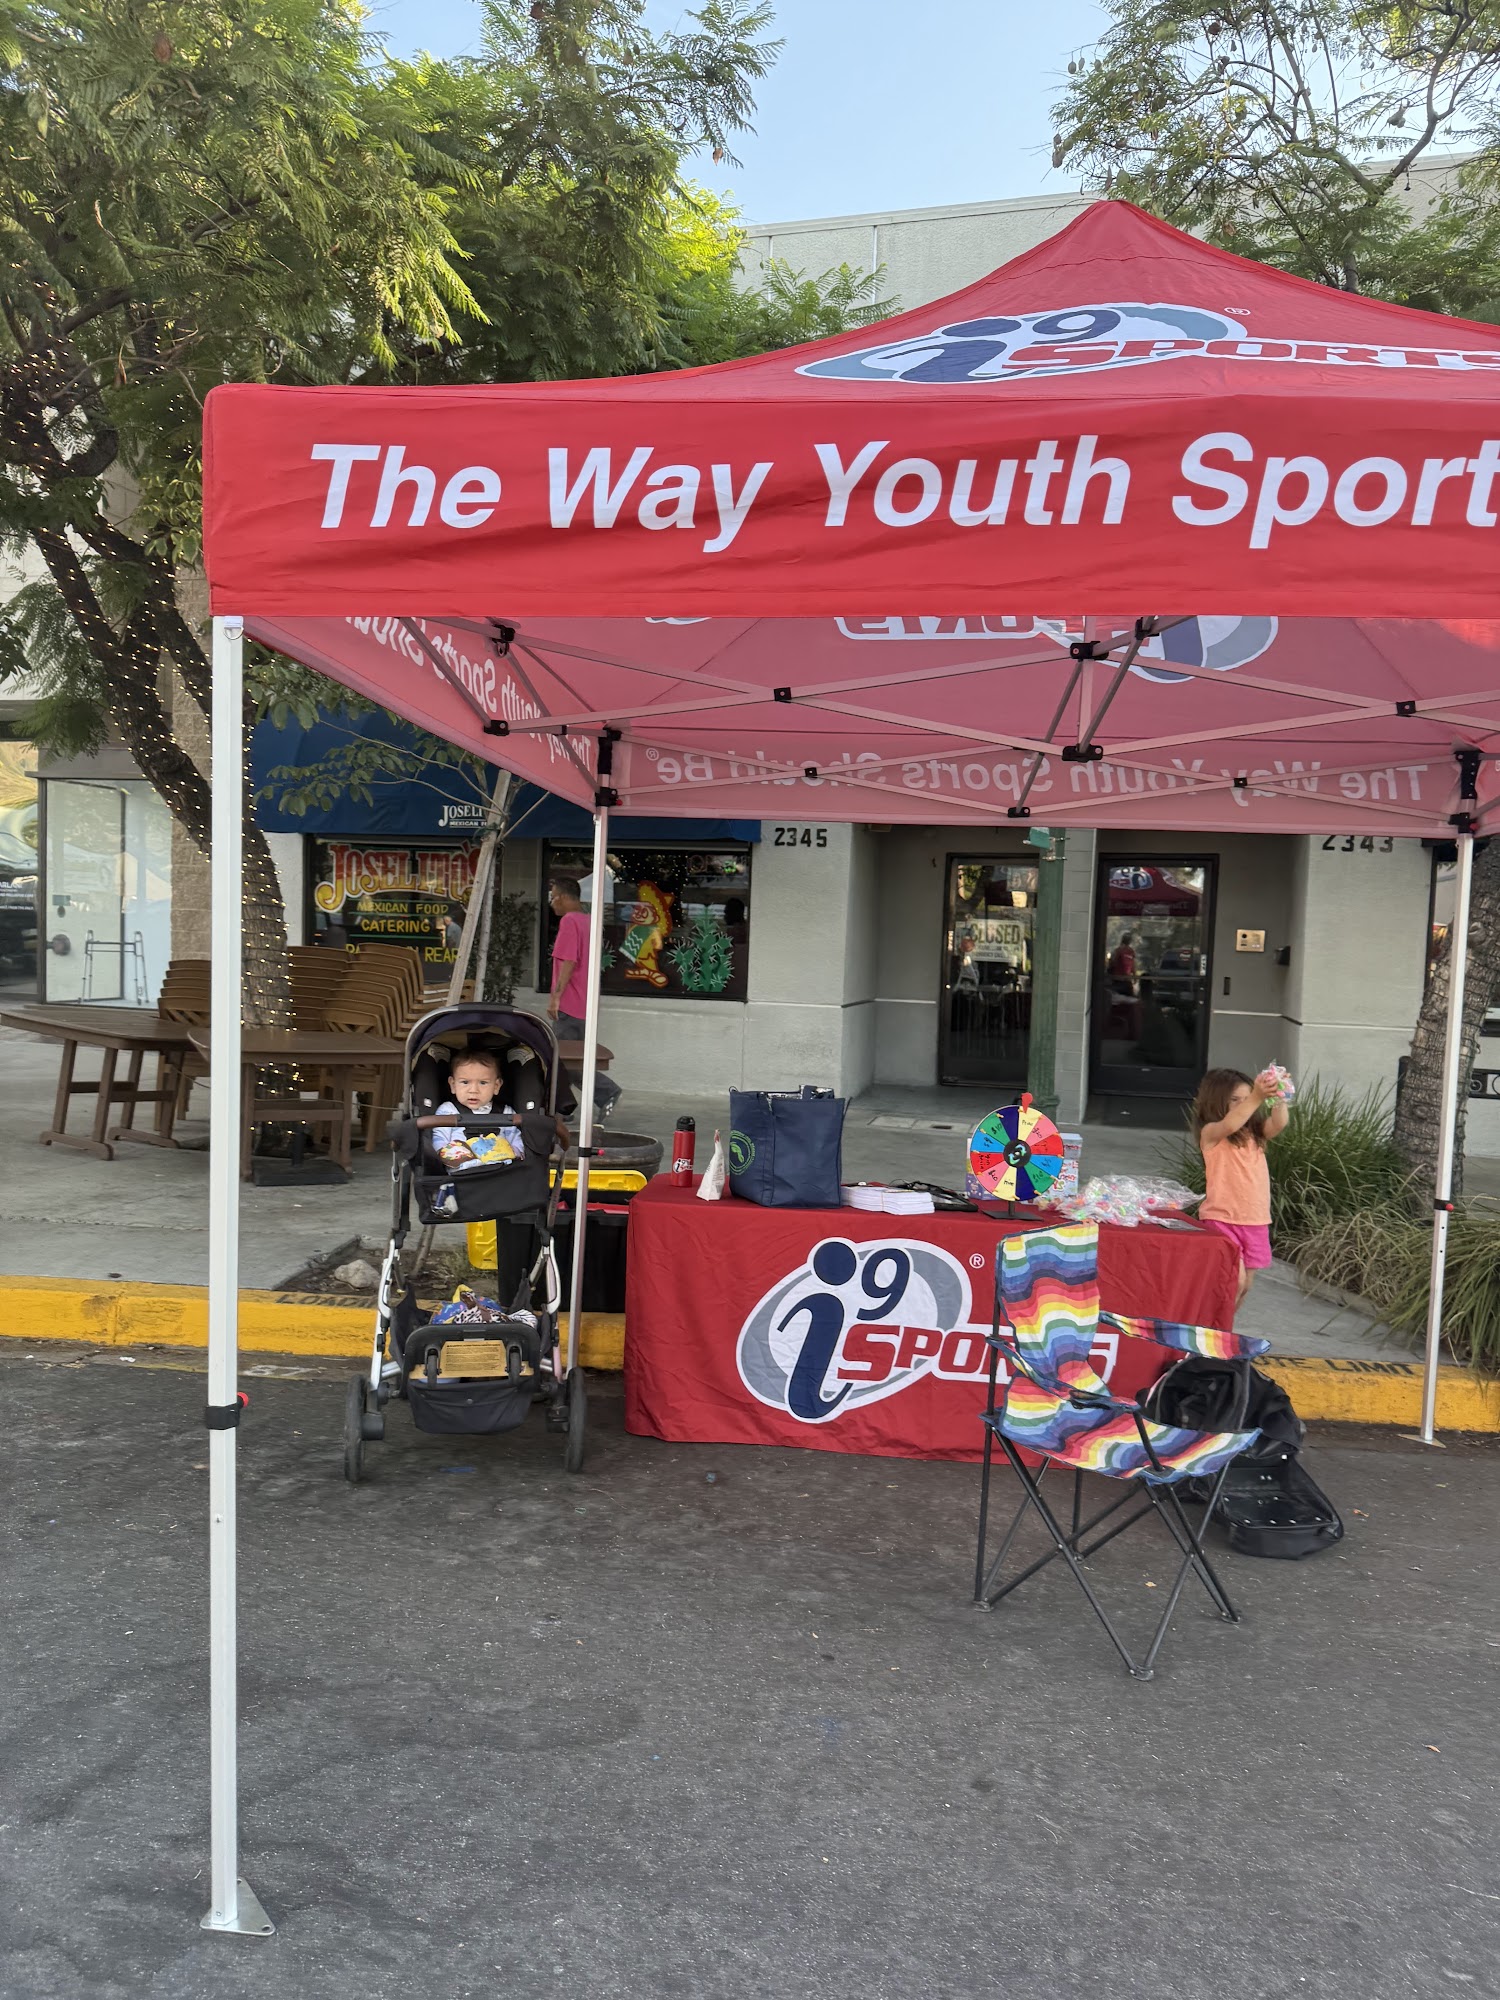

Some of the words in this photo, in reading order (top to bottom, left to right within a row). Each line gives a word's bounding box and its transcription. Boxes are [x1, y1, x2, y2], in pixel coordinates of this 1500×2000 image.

[311, 443, 501, 529] The
[548, 446, 774, 553] Way
[813, 434, 1131, 527] Youth
[774, 827, 828, 848] 2345
[356, 902, 408, 913] MEXICAN
[415, 903, 449, 914] FOOD
[361, 919, 431, 933] CATERING
[776, 1241, 911, 1419] i9
[1325, 1359, 1416, 1376] LIMIT
